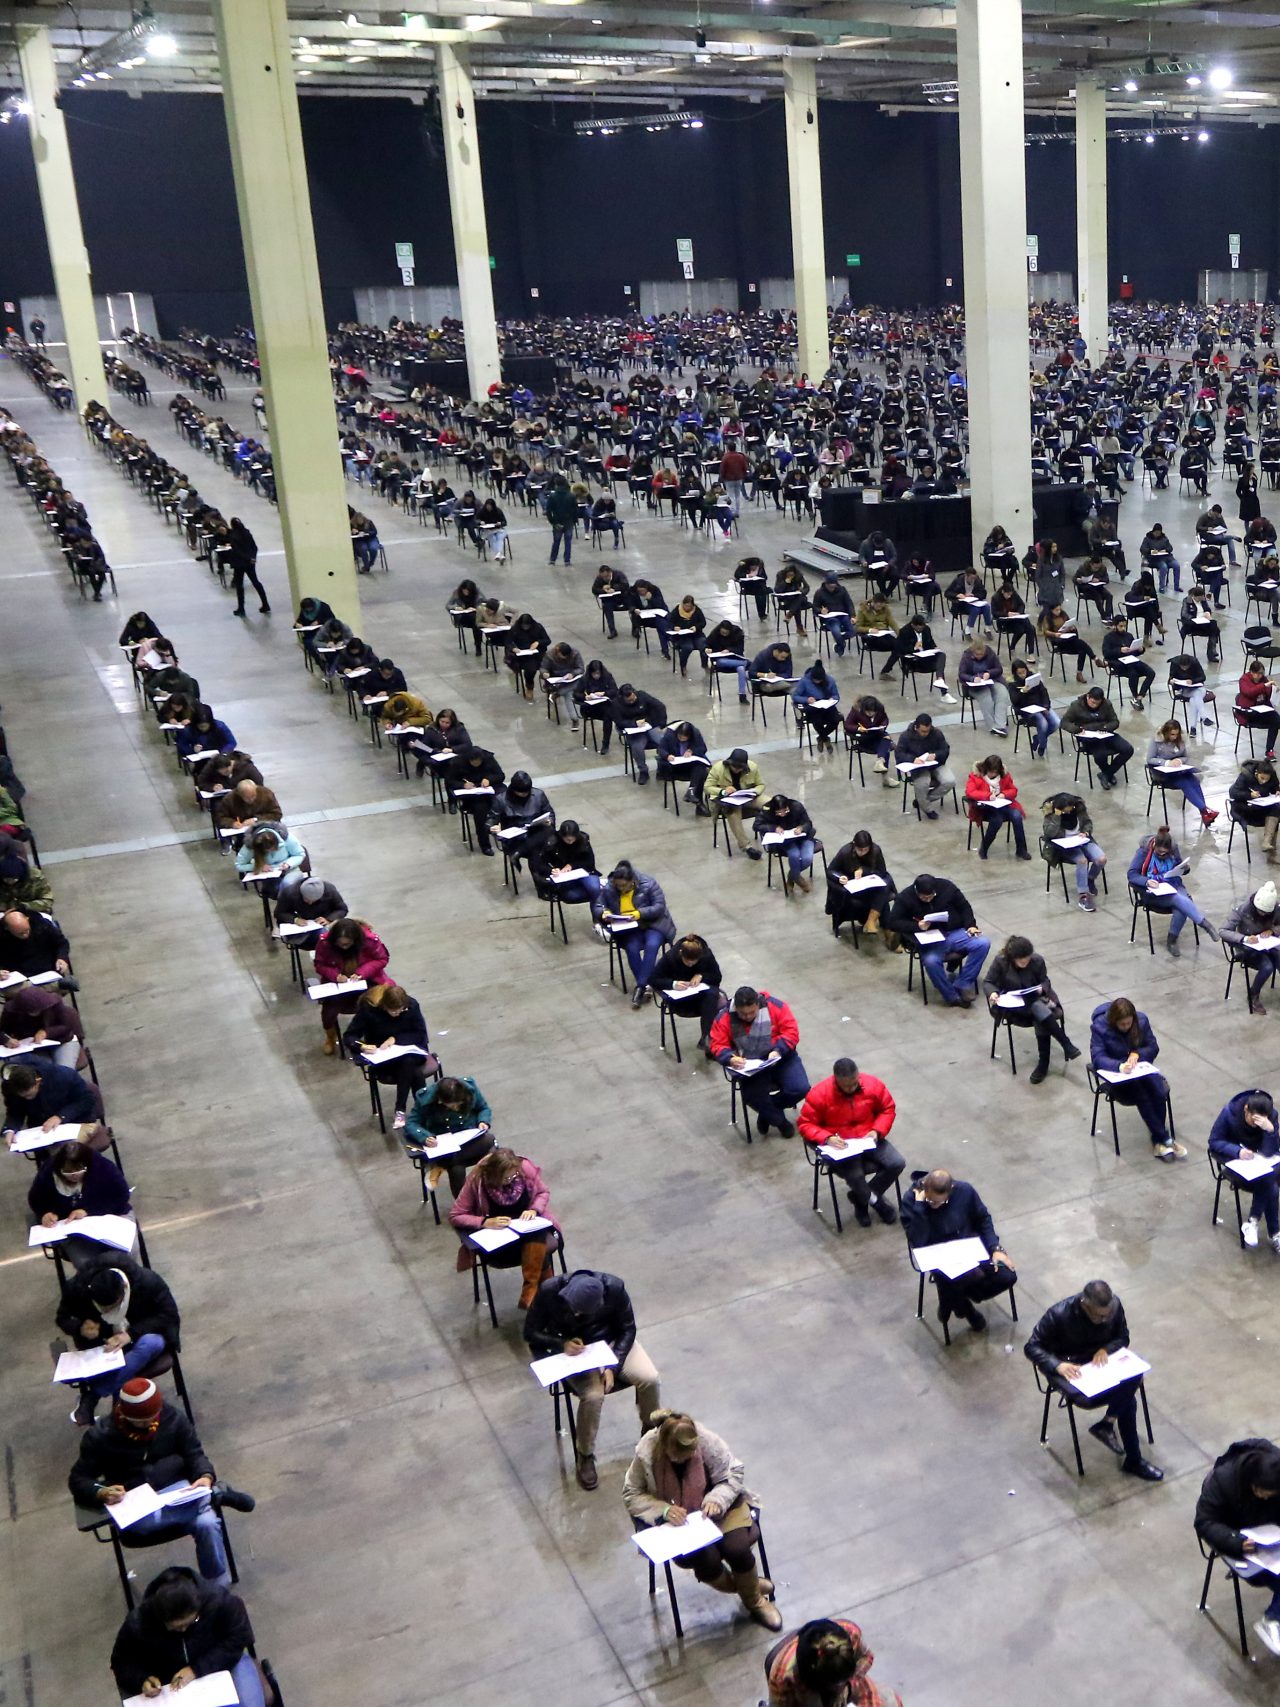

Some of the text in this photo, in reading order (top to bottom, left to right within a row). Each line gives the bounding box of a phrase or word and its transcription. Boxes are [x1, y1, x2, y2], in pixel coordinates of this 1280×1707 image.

[1030, 258, 1037, 269] 6
[1232, 255, 1238, 266] 7
[684, 264, 692, 276] 4
[403, 270, 412, 283] 3
